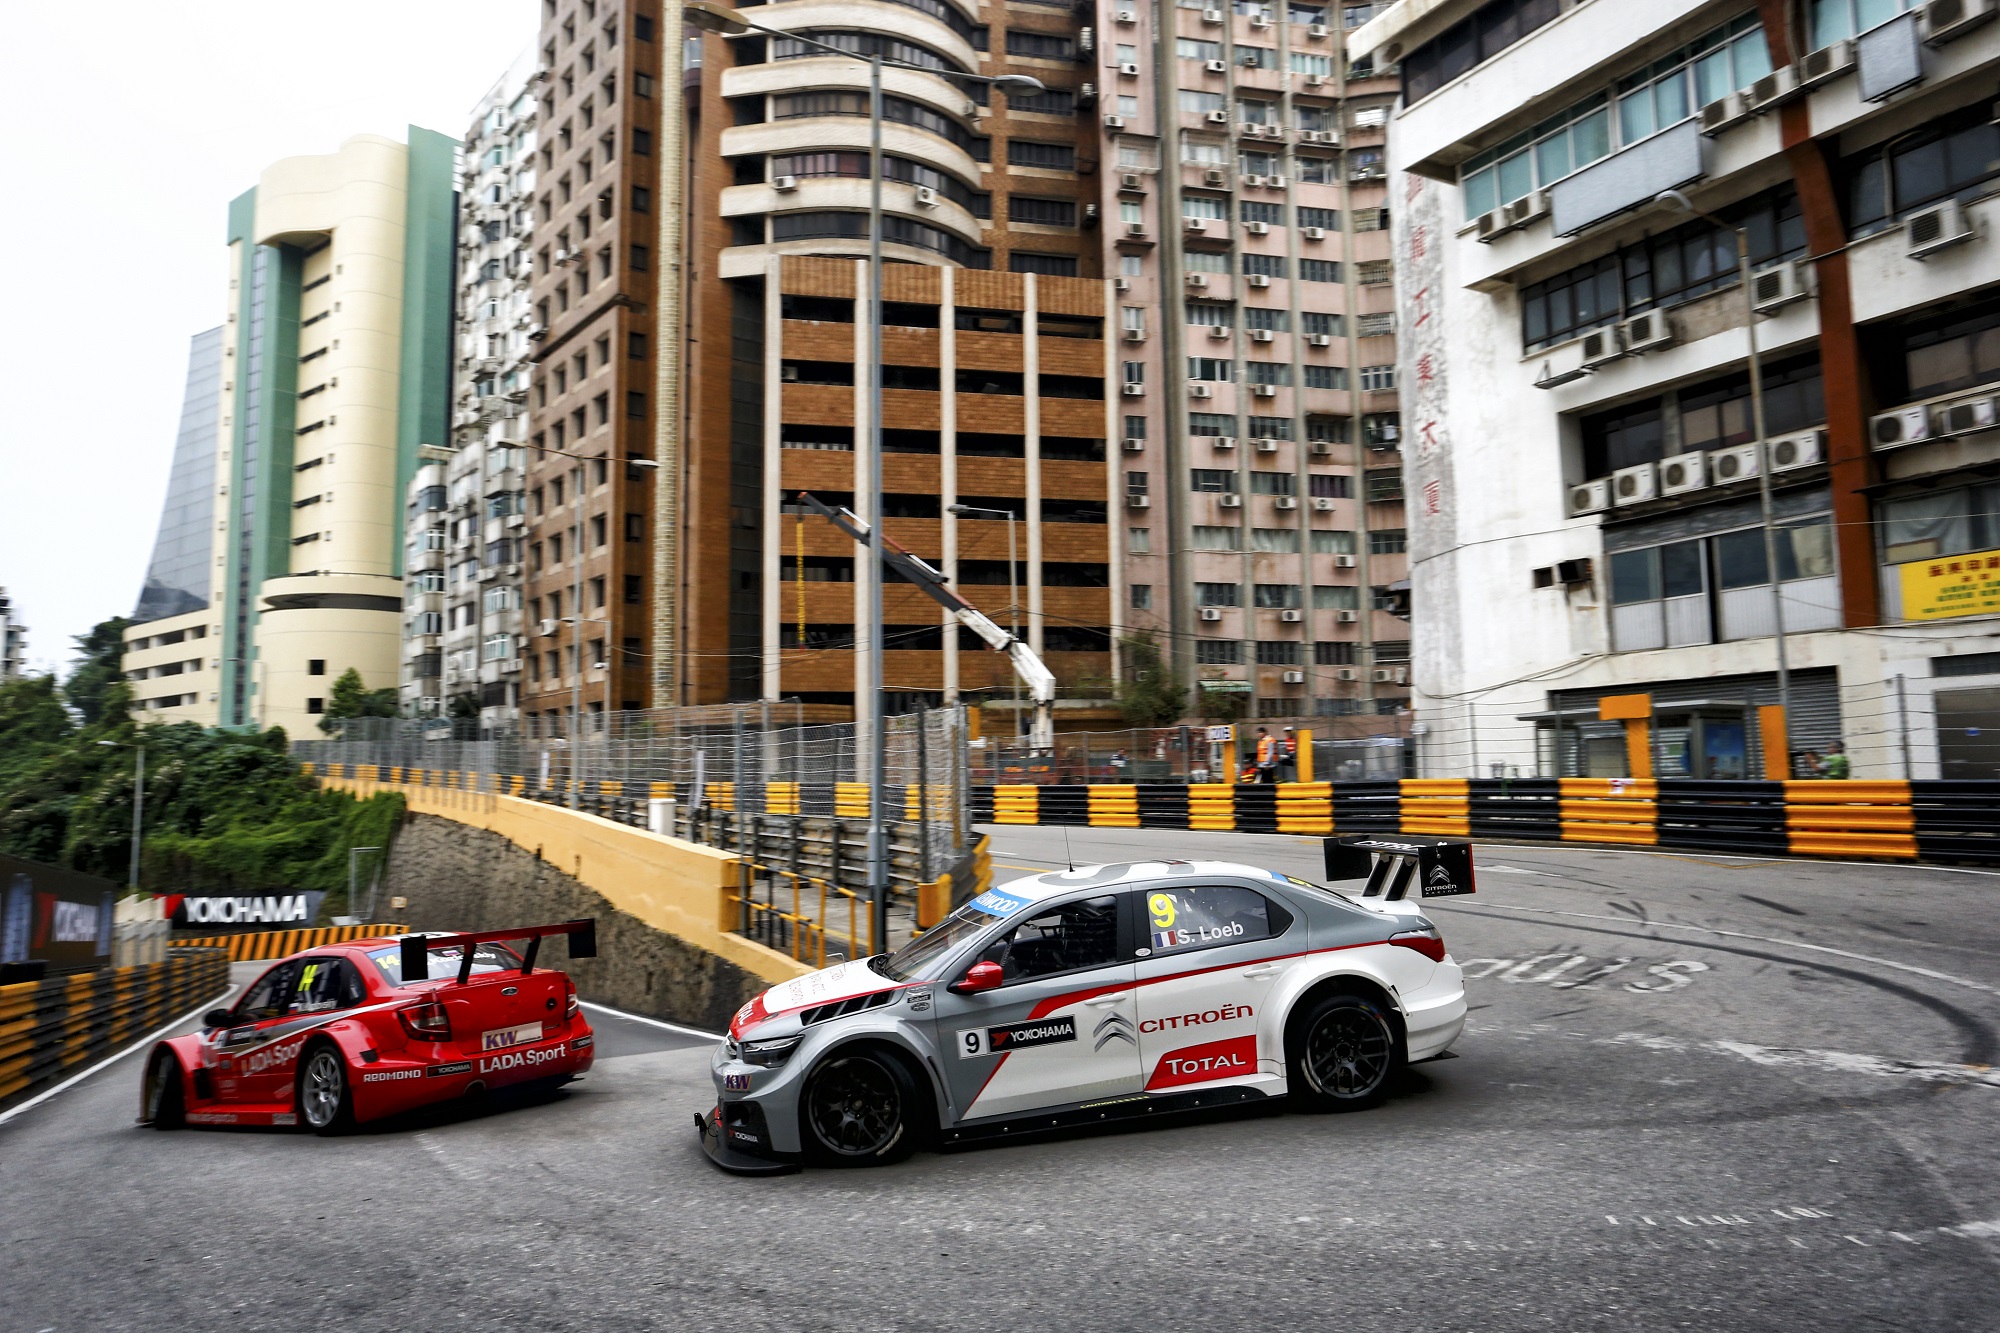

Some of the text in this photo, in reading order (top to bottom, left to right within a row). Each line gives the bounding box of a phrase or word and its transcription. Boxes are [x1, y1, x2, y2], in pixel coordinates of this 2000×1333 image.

[184, 895, 307, 923] YOKOHAMA
[1149, 893, 1175, 928] 9
[1178, 921, 1244, 945] S. Loeb
[376, 955, 400, 970] 14
[485, 1030, 518, 1050] KW
[965, 1032, 980, 1054] 9
[1010, 1023, 1073, 1042] YOKOHAMA
[438, 1063, 471, 1074] YOKOHAMA
[480, 1053, 525, 1074] LADA
[526, 1044, 566, 1066] Sport
[1165, 1053, 1246, 1075] TOTAL
[725, 1074, 752, 1090] KW
